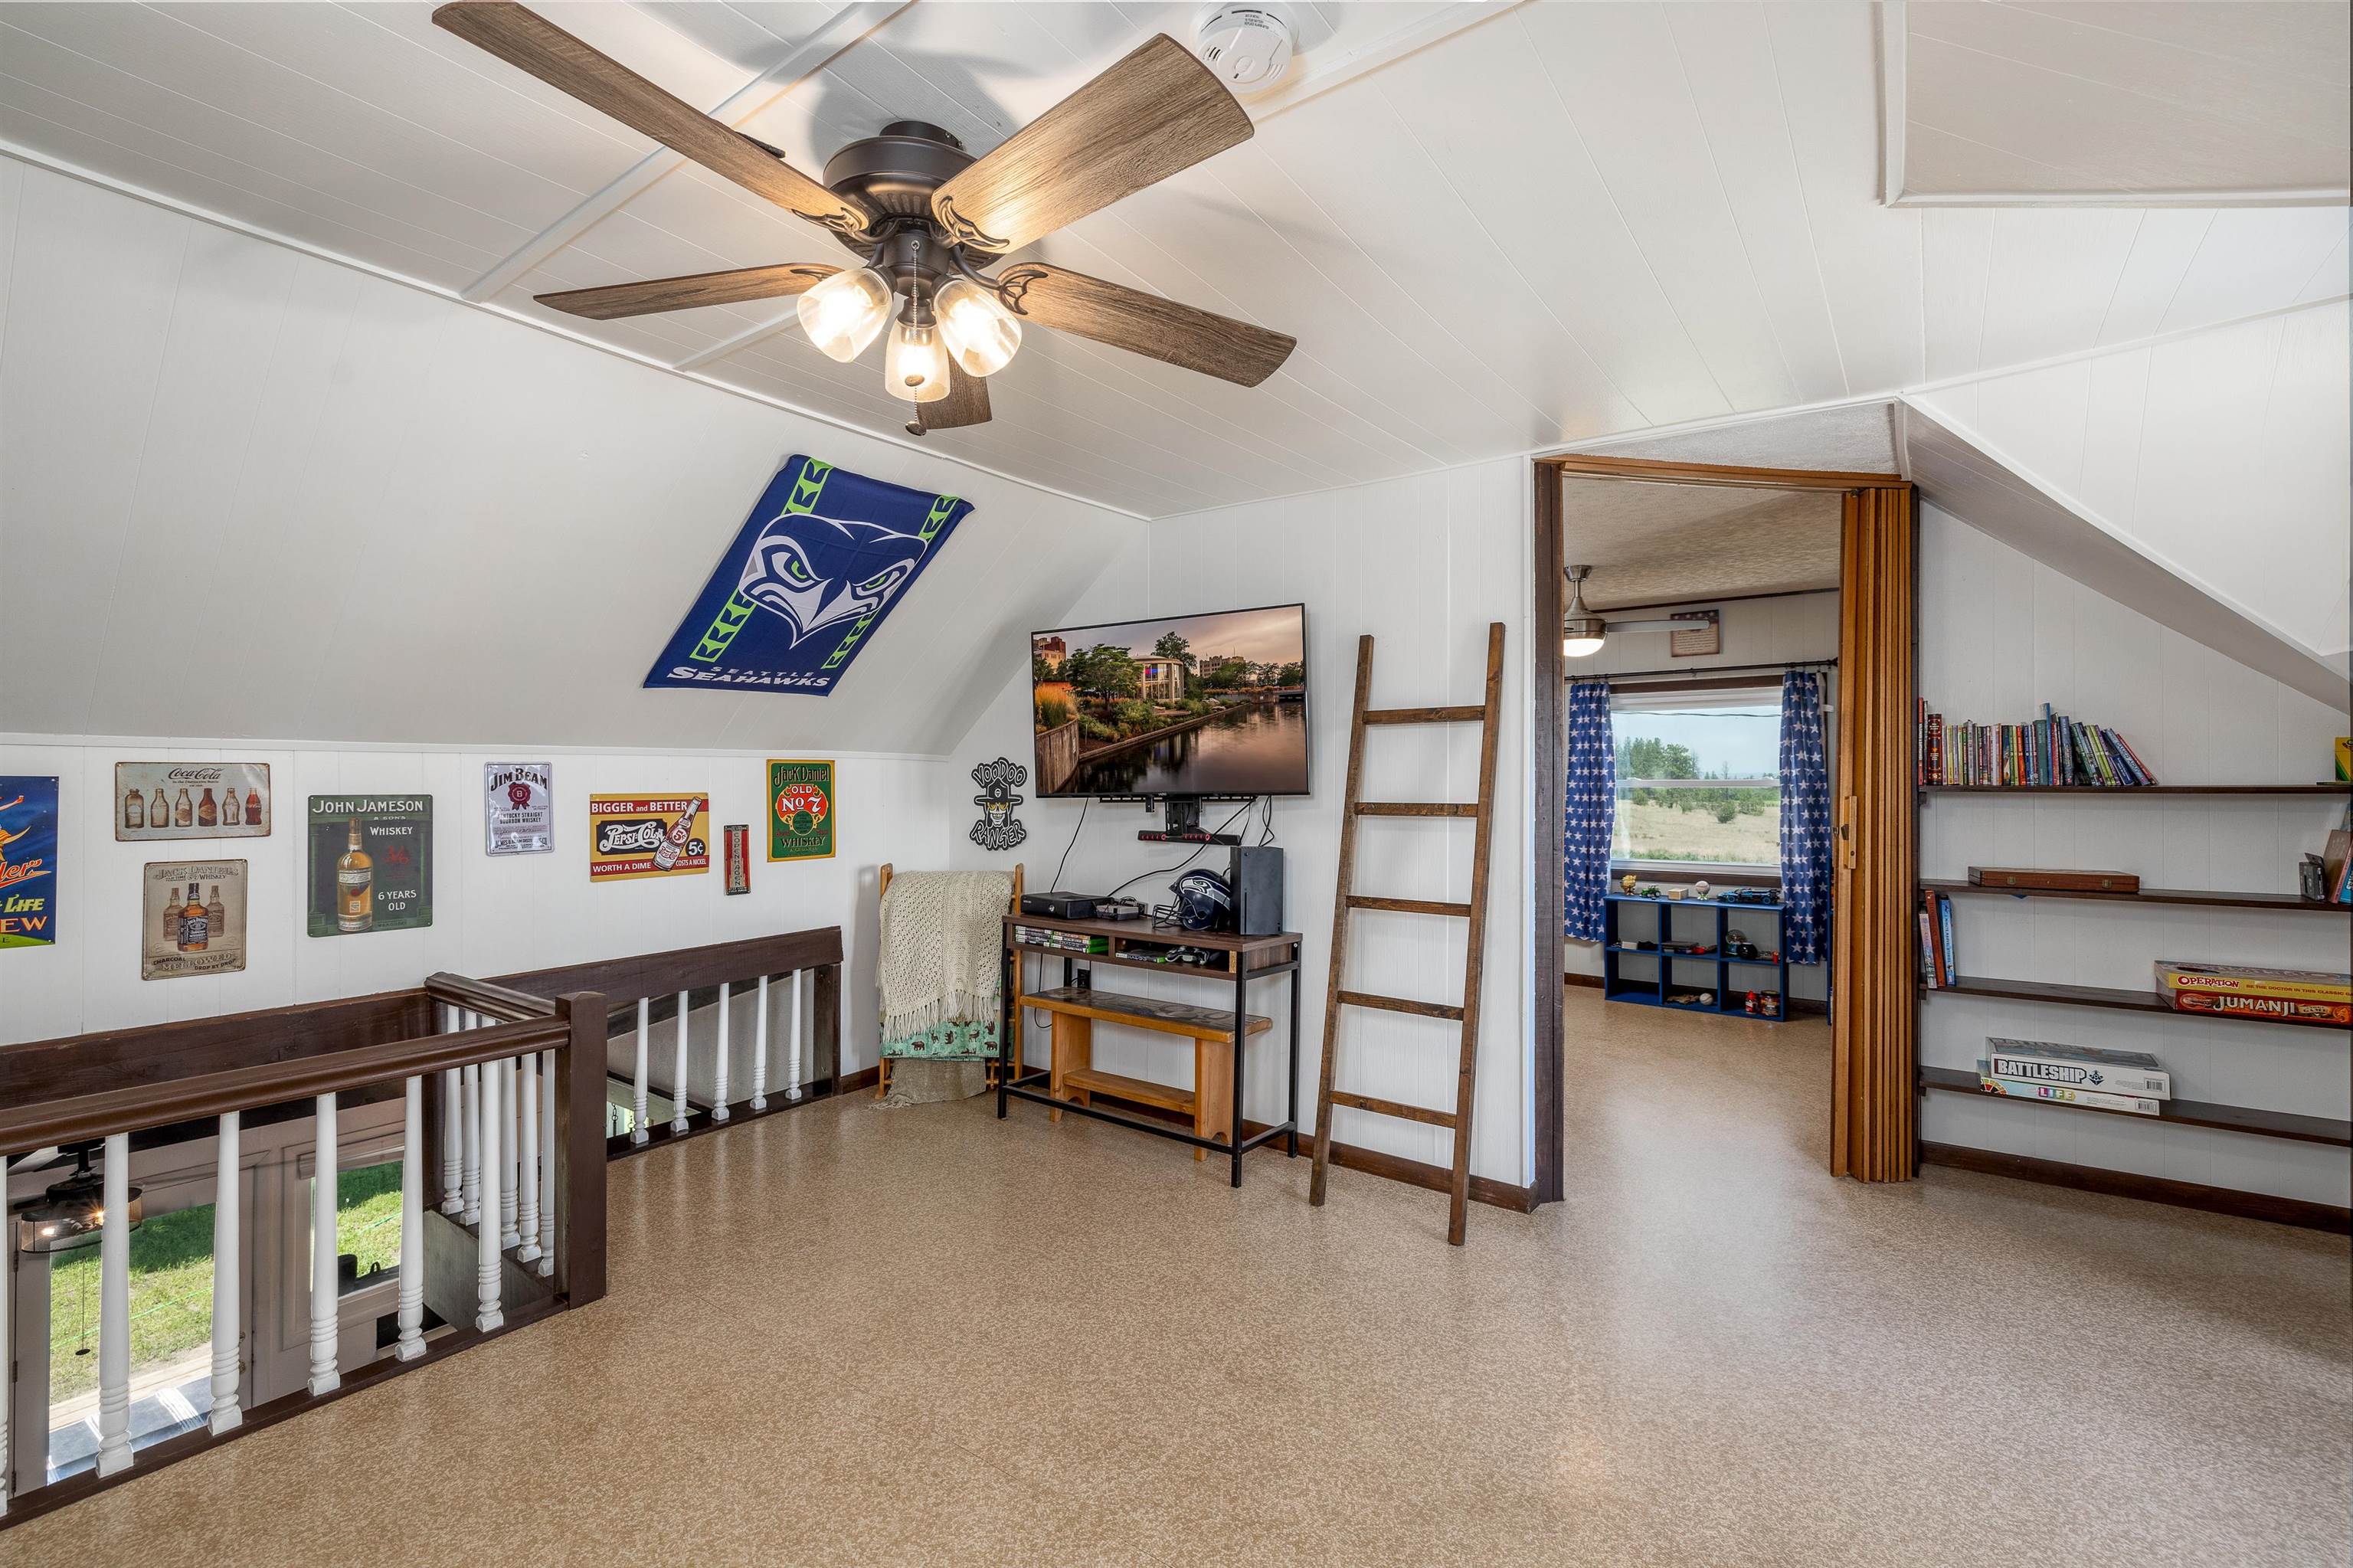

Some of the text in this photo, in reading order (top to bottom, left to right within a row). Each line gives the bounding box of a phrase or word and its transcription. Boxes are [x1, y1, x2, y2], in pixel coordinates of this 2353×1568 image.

[667, 666, 831, 686] SEAHAWKS
[711, 666, 815, 676] SEATTLE
[490, 768, 548, 791] JIM BEAM
[801, 766, 830, 781] Daniel
[972, 759, 1026, 786] VOODOO
[313, 799, 423, 813] JOHN JAMESON
[592, 802, 633, 813] BIGGER
[650, 801, 687, 811] BETTER
[807, 797, 822, 813] 7
[369, 827, 413, 836] WHISKEY
[971, 821, 1026, 848] RANGER
[781, 836, 826, 848] WHISKEY
[593, 864, 622, 872] WORTH
[378, 889, 417, 900] 6 YEARS
[4, 894, 44, 913] LIFE
[388, 902, 406, 912] OLD
[153, 956, 185, 965] CHARCOAL
[2178, 975, 2240, 988] OPERATION
[2213, 996, 2296, 1017] JUMANJI
[1998, 1059, 2085, 1083] BATTLESHIP
[2040, 1087, 2073, 1101] LIFE
